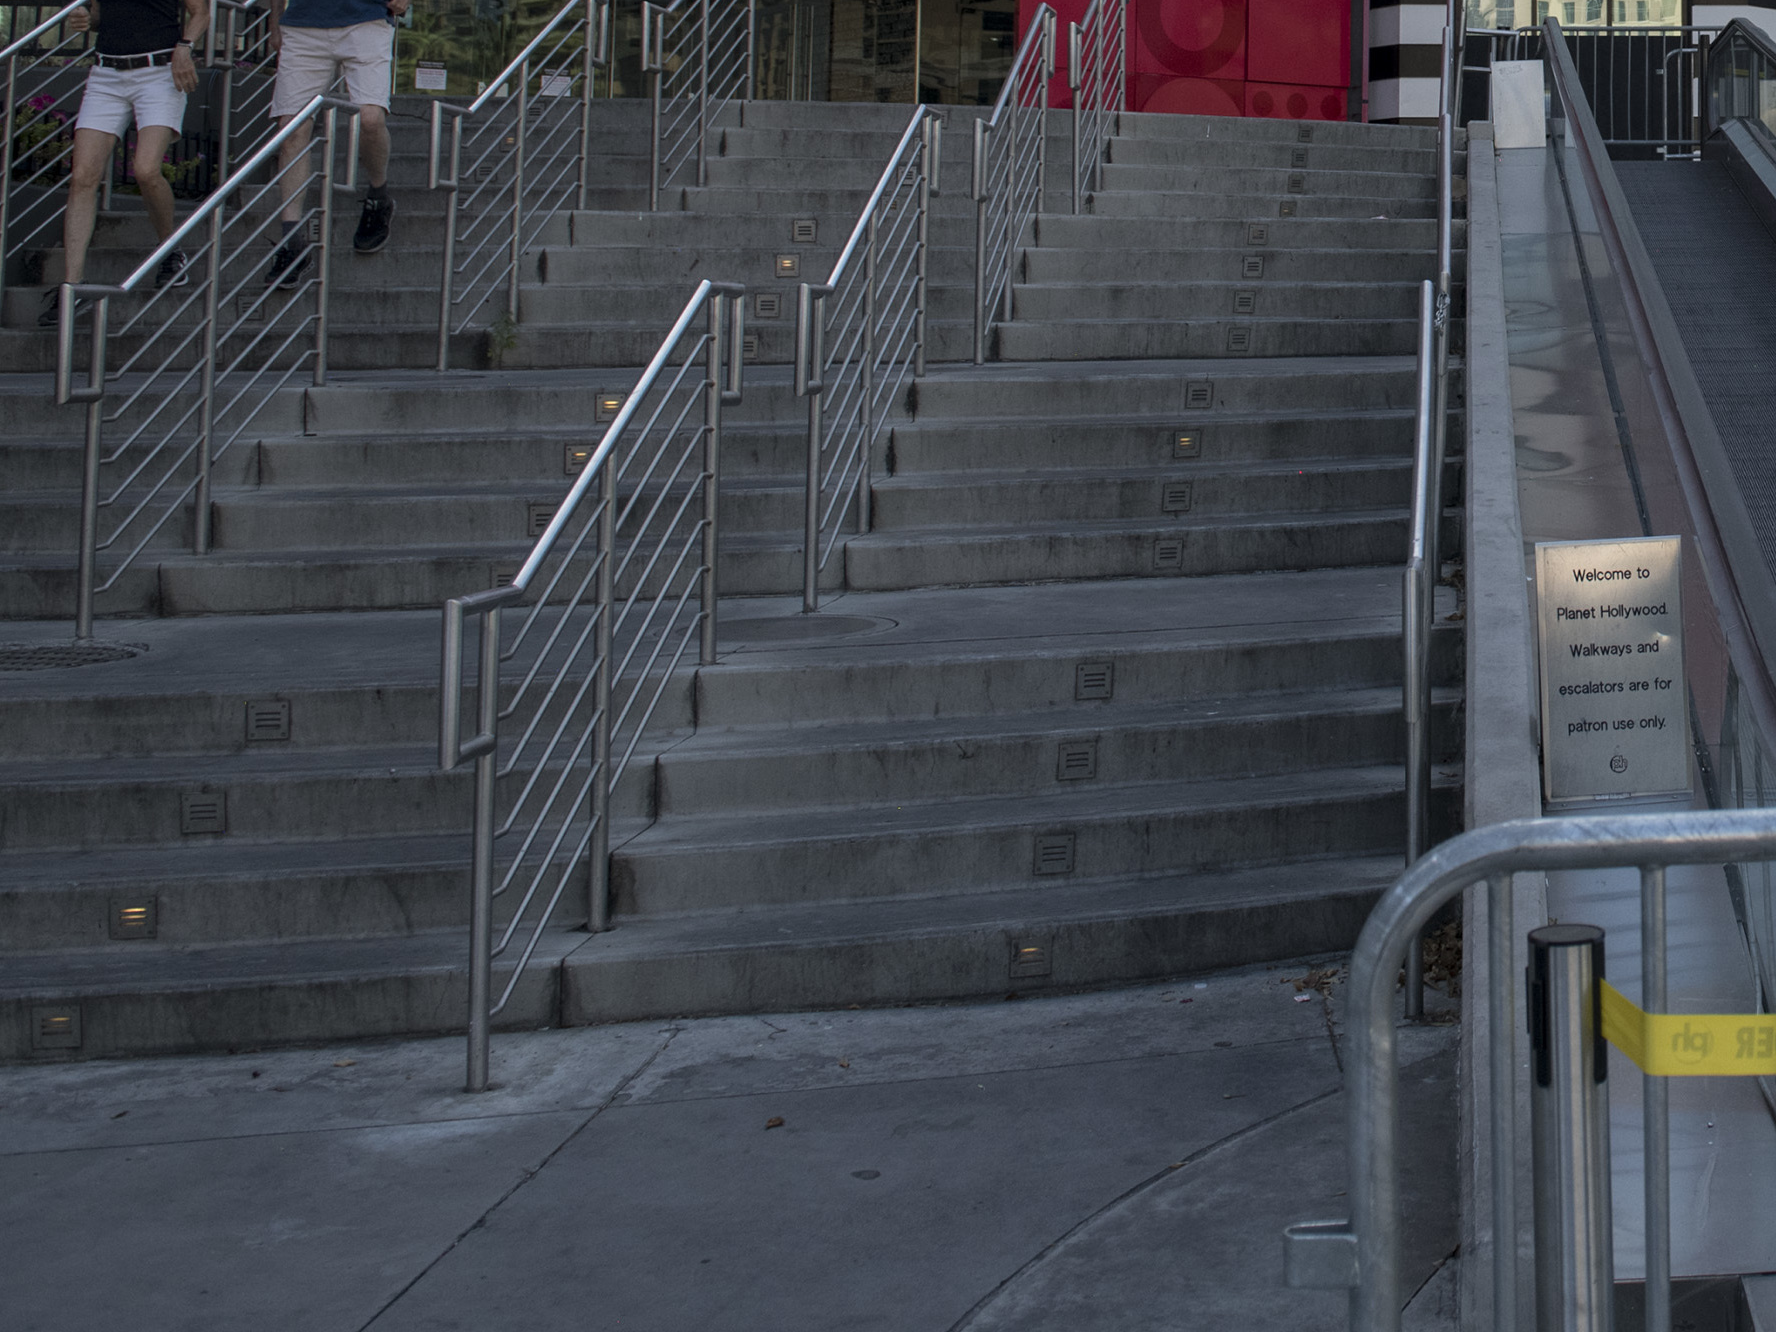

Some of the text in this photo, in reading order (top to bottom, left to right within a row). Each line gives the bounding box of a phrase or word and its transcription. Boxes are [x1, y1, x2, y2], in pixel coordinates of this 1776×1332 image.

[1573, 567, 1650, 582] Welcome to
[1557, 602, 1668, 621] Planet Hollywood.
[1570, 640, 1659, 657] Walkways and
[1559, 677, 1672, 695] escalators are for
[1568, 715, 1666, 736] patron use only.
